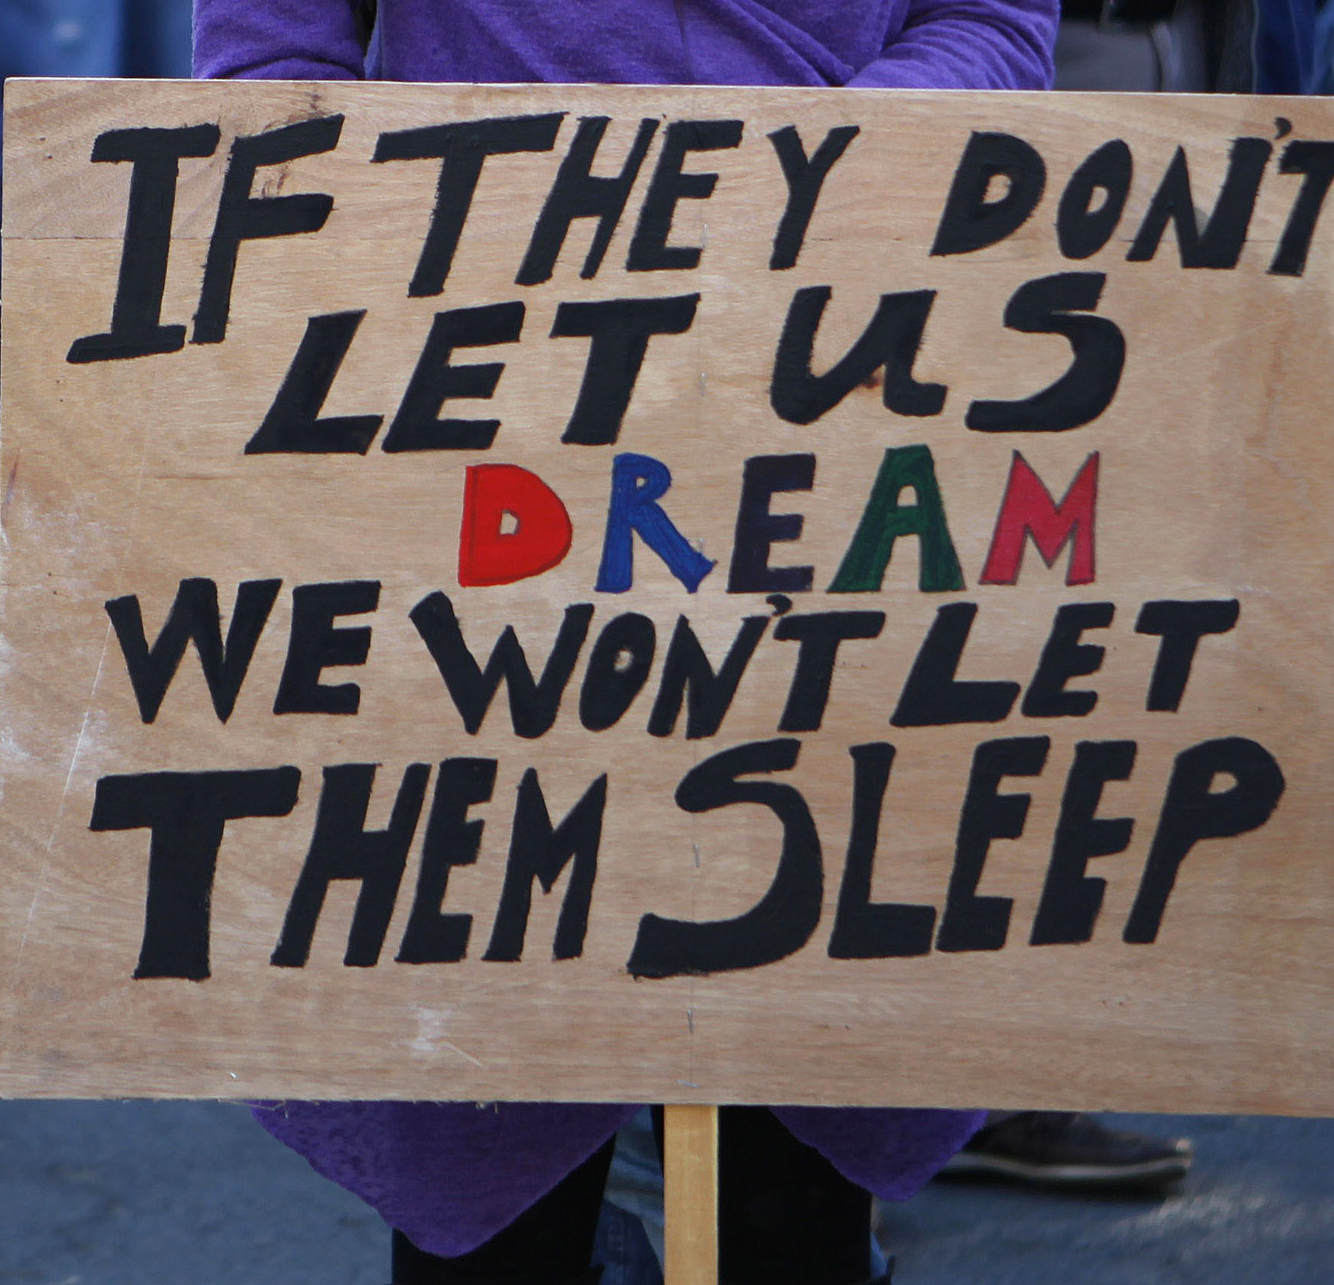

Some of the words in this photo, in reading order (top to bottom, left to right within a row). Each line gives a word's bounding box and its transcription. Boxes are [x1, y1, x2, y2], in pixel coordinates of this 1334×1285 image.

[66, 112, 345, 365] IF
[370, 110, 860, 299] THEY
[244, 291, 701, 456] LET
[457, 443, 1101, 594] DREAM
[104, 577, 382, 726] WE
[408, 588, 887, 741] WON'T
[889, 598, 1241, 728] LET
[88, 760, 608, 983] THEM
[625, 734, 1288, 981] SLEEP
